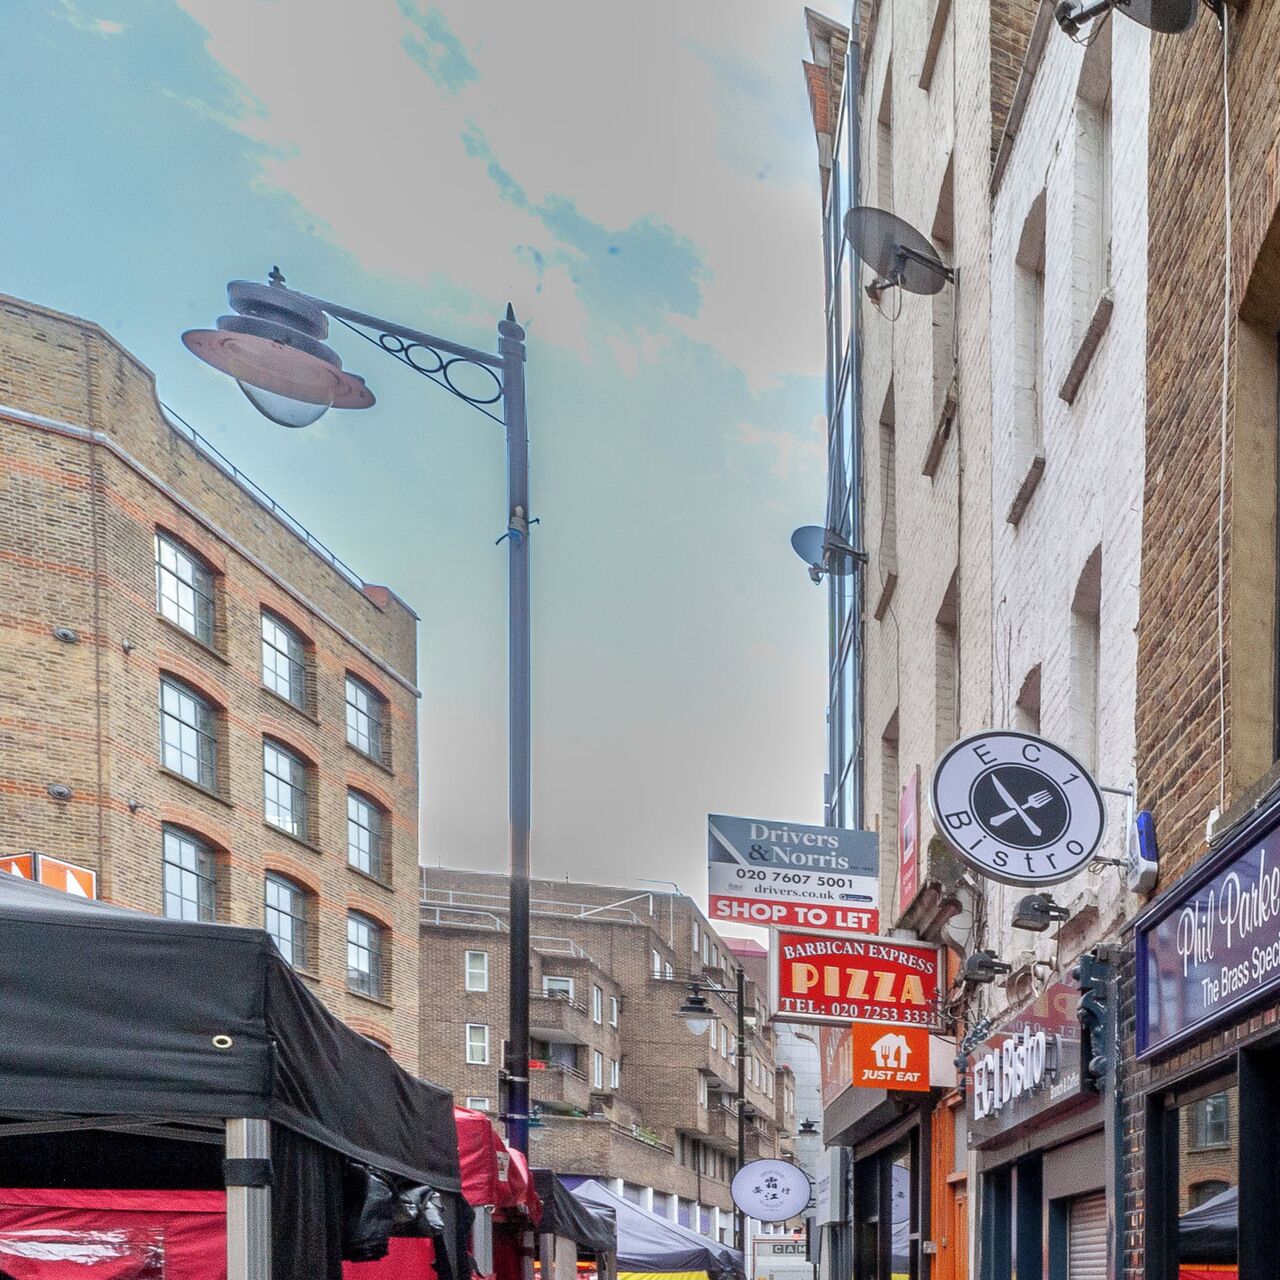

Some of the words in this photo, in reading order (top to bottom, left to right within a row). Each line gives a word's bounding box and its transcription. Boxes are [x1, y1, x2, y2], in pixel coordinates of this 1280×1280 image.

[973, 743, 1080, 786] EC1
[750, 823, 839, 849] Drivers
[944, 810, 1084, 873] Bistro
[772, 846, 849, 870] Norris
[736, 868, 767, 881] 020
[772, 872, 811, 885] 7607
[817, 877, 853, 889] 5001
[754, 884, 835, 901] drivers.co.uk
[716, 900, 787, 921] SHOP
[795, 907, 828, 925] TO
[836, 911, 872, 929] LET
[1177, 889, 1214, 978] Phil
[784, 941, 865, 960] BARBICAN
[868, 944, 935, 975] EXPRESS
[791, 962, 927, 1006] PIZZA
[1202, 977, 1220, 1008] The
[1221, 960, 1250, 998] Brass
[781, 997, 826, 1015] TEL:
[831, 1002, 858, 1018] 020
[864, 1006, 898, 1021] 7253
[862, 1069, 895, 1081] JUST
[896, 1072, 921, 1082] EAT
[1002, 1025, 1047, 1104] Bistro
